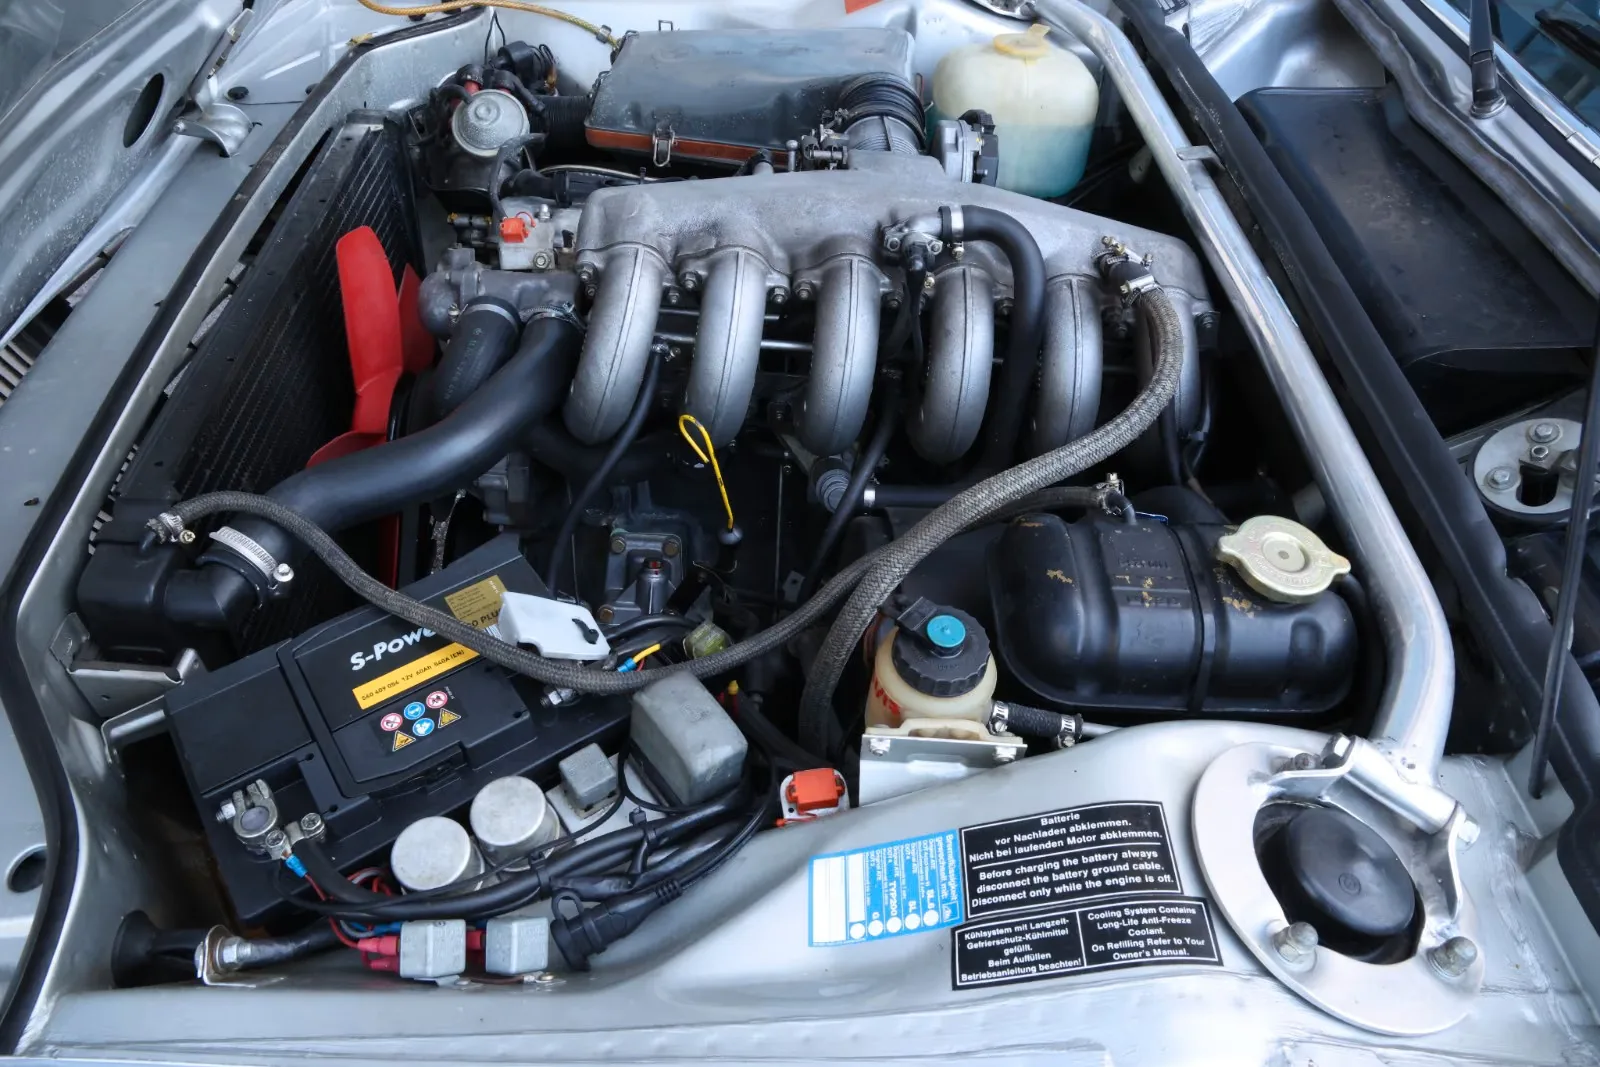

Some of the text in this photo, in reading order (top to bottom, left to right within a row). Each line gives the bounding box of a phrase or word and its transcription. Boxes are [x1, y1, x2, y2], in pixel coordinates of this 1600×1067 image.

[480, 607, 500, 623] PLU
[350, 626, 436, 671] S-Powe
[402, 674, 414, 682] 12V
[1040, 812, 1080, 826] Batterie
[994, 818, 1132, 846] vor Nachladen abklemmen.
[969, 829, 1163, 862] Nicht bei laufenden Motor abklemmen.
[979, 848, 1158, 880] Before charging the battery always
[976, 862, 1164, 894] disconnect the battery ground cable.
[888, 880, 898, 916] TYP200
[972, 873, 1174, 908] Disconnect only while the engine is off.
[1088, 906, 1196, 920] Cooling System Contains
[964, 918, 1070, 940] Kühlsystem mit Langzeit-
[1097, 916, 1192, 930] Long-Life Anti-Freeze
[1128, 927, 1166, 936] Coolant.
[966, 928, 1069, 950] Gefrierschutz-Kühlmittel
[1092, 936, 1206, 952] On Refilling Refer to Your
[1004, 944, 1033, 956] gefüllt.
[1112, 947, 1190, 960] Owner's Manual.
[961, 958, 1082, 981] Betriebsanleitung beachten!
[988, 952, 1052, 968] Beim Auffüllen
